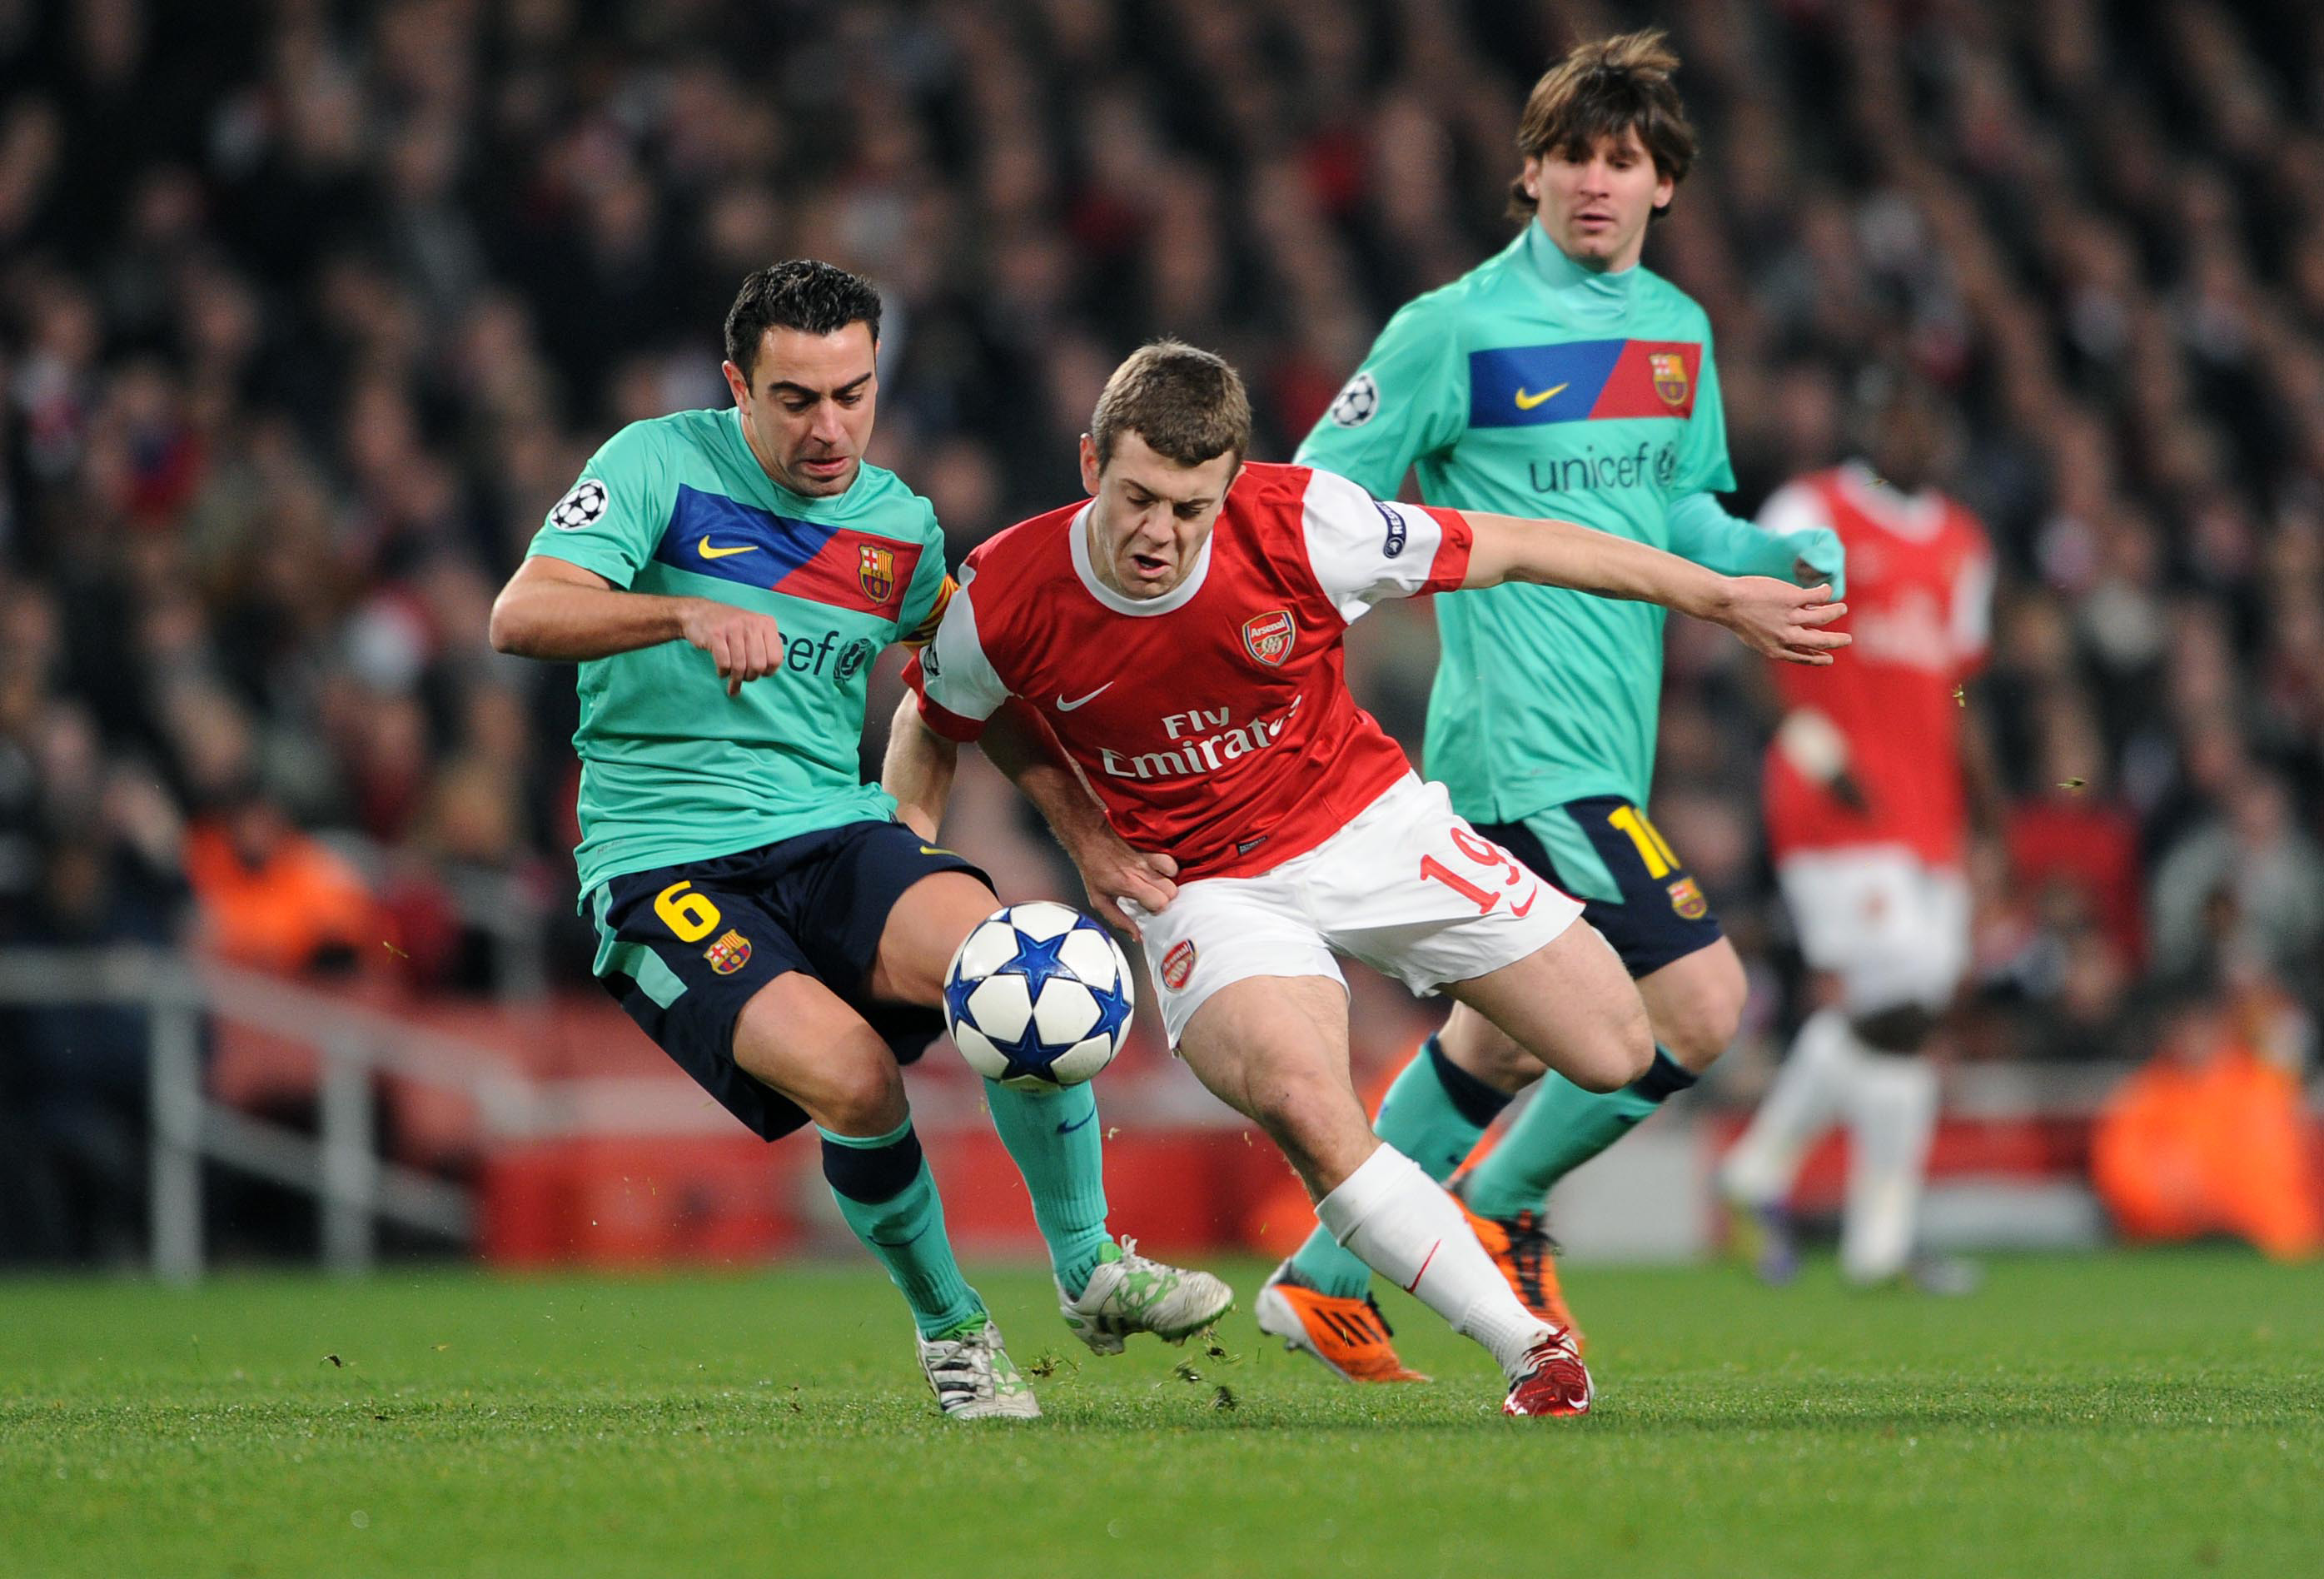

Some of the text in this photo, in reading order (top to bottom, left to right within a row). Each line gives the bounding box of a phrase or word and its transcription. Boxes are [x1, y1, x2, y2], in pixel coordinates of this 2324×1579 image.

[1529, 442, 1650, 493] unicef
[1252, 619, 1286, 638] Arsenal
[1161, 706, 1229, 740] Fly
[1420, 827, 1521, 915] 19
[654, 879, 721, 943] 6
